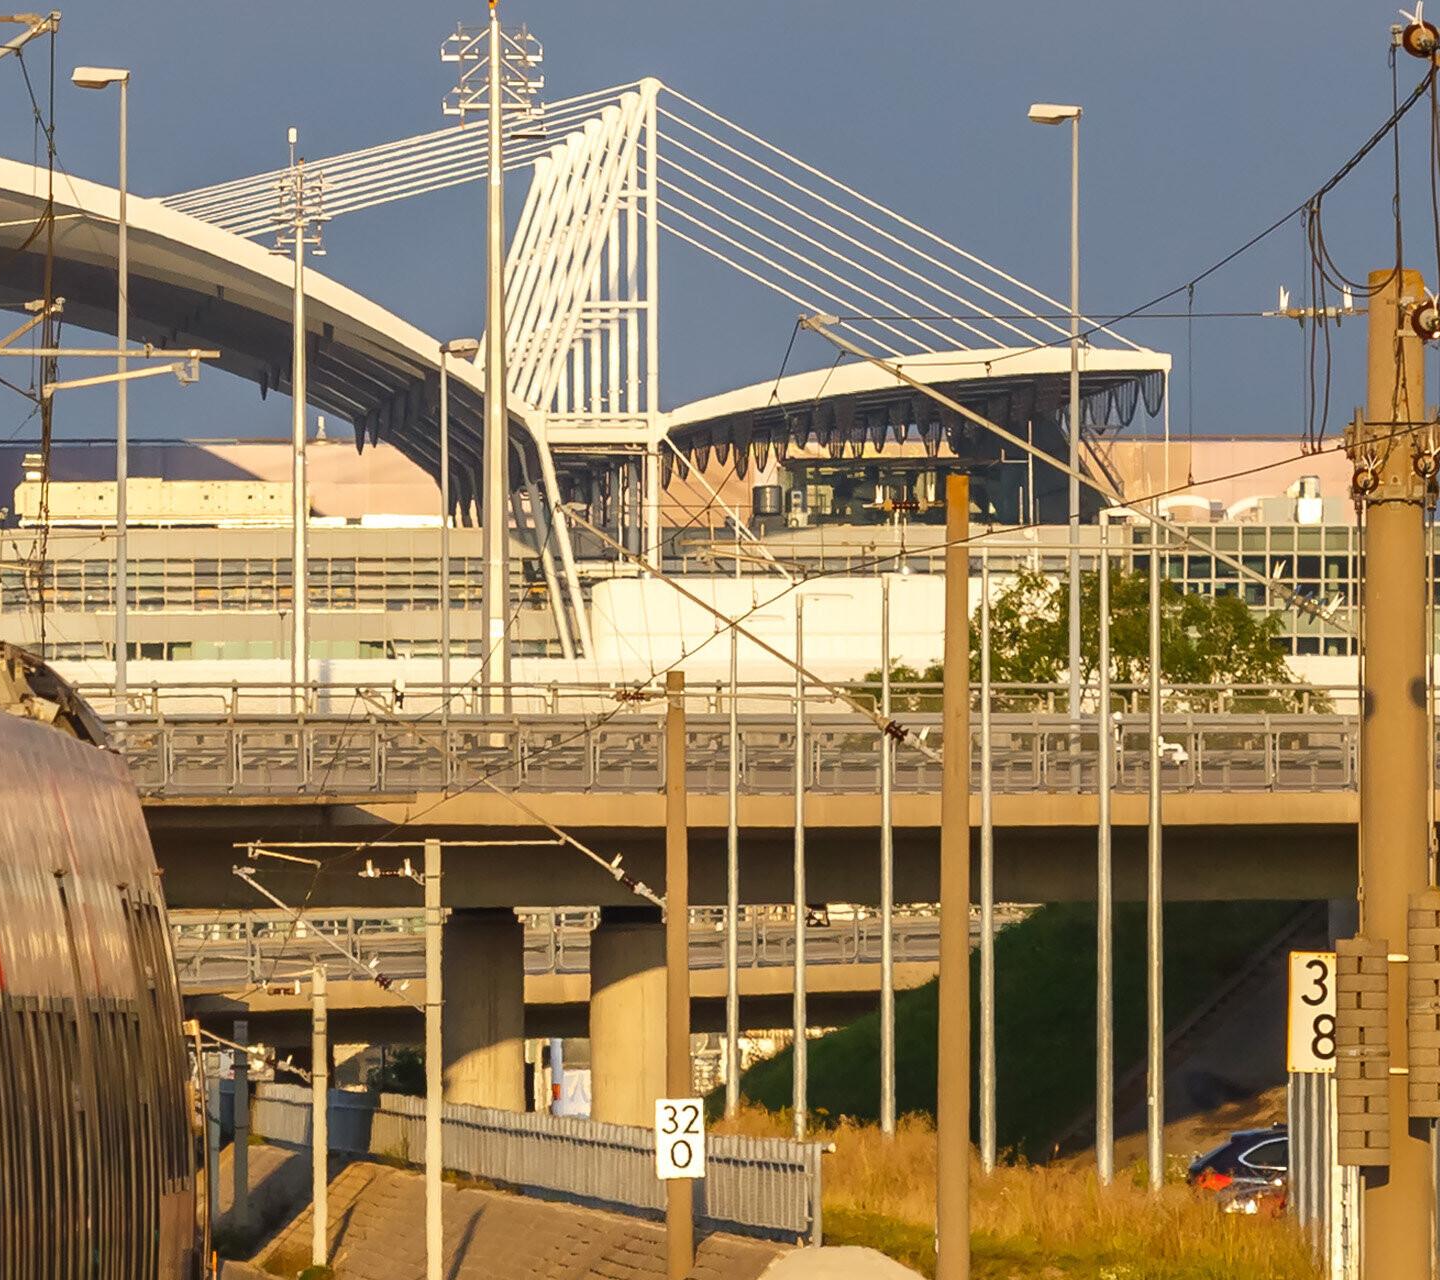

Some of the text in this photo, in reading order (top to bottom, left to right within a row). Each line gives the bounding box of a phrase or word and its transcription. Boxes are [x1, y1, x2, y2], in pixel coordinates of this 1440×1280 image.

[1301, 959, 1328, 1006] 3
[1311, 1014, 1336, 1060] 8
[662, 1105, 699, 1134] 32
[671, 1140, 692, 1168] 0
